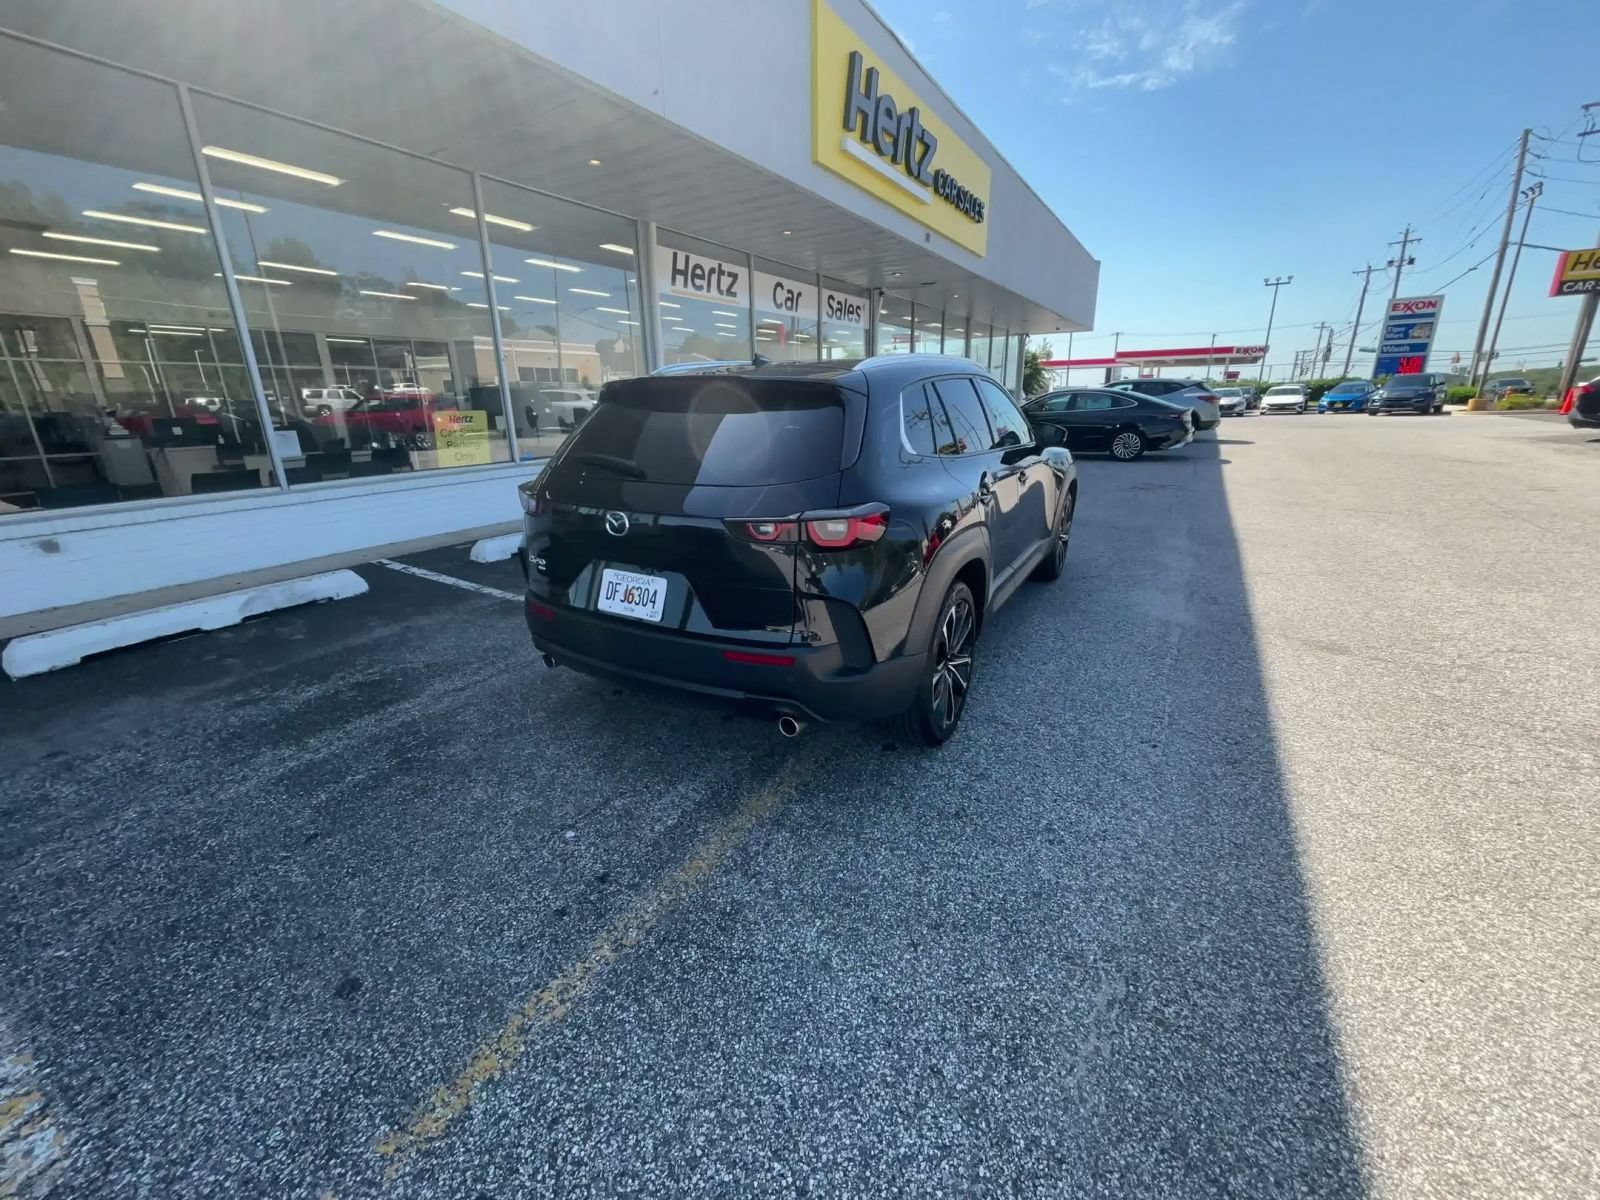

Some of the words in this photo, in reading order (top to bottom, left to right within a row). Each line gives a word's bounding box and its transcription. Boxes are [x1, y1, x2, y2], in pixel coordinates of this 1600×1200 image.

[843, 50, 938, 187] Hertz
[934, 168, 958, 206] CAR
[958, 185, 985, 223] SALES
[671, 251, 739, 298] Hertz
[772, 282, 802, 312] Car
[826, 294, 862, 323] Sales
[1563, 281, 1595, 292] CAR
[1391, 300, 1438, 314] EXXON
[1236, 345, 1265, 355] EXXON
[449, 415, 473, 424] Hertz
[616, 573, 651, 586] GEORGIA
[605, 581, 657, 609] DFJ6304
